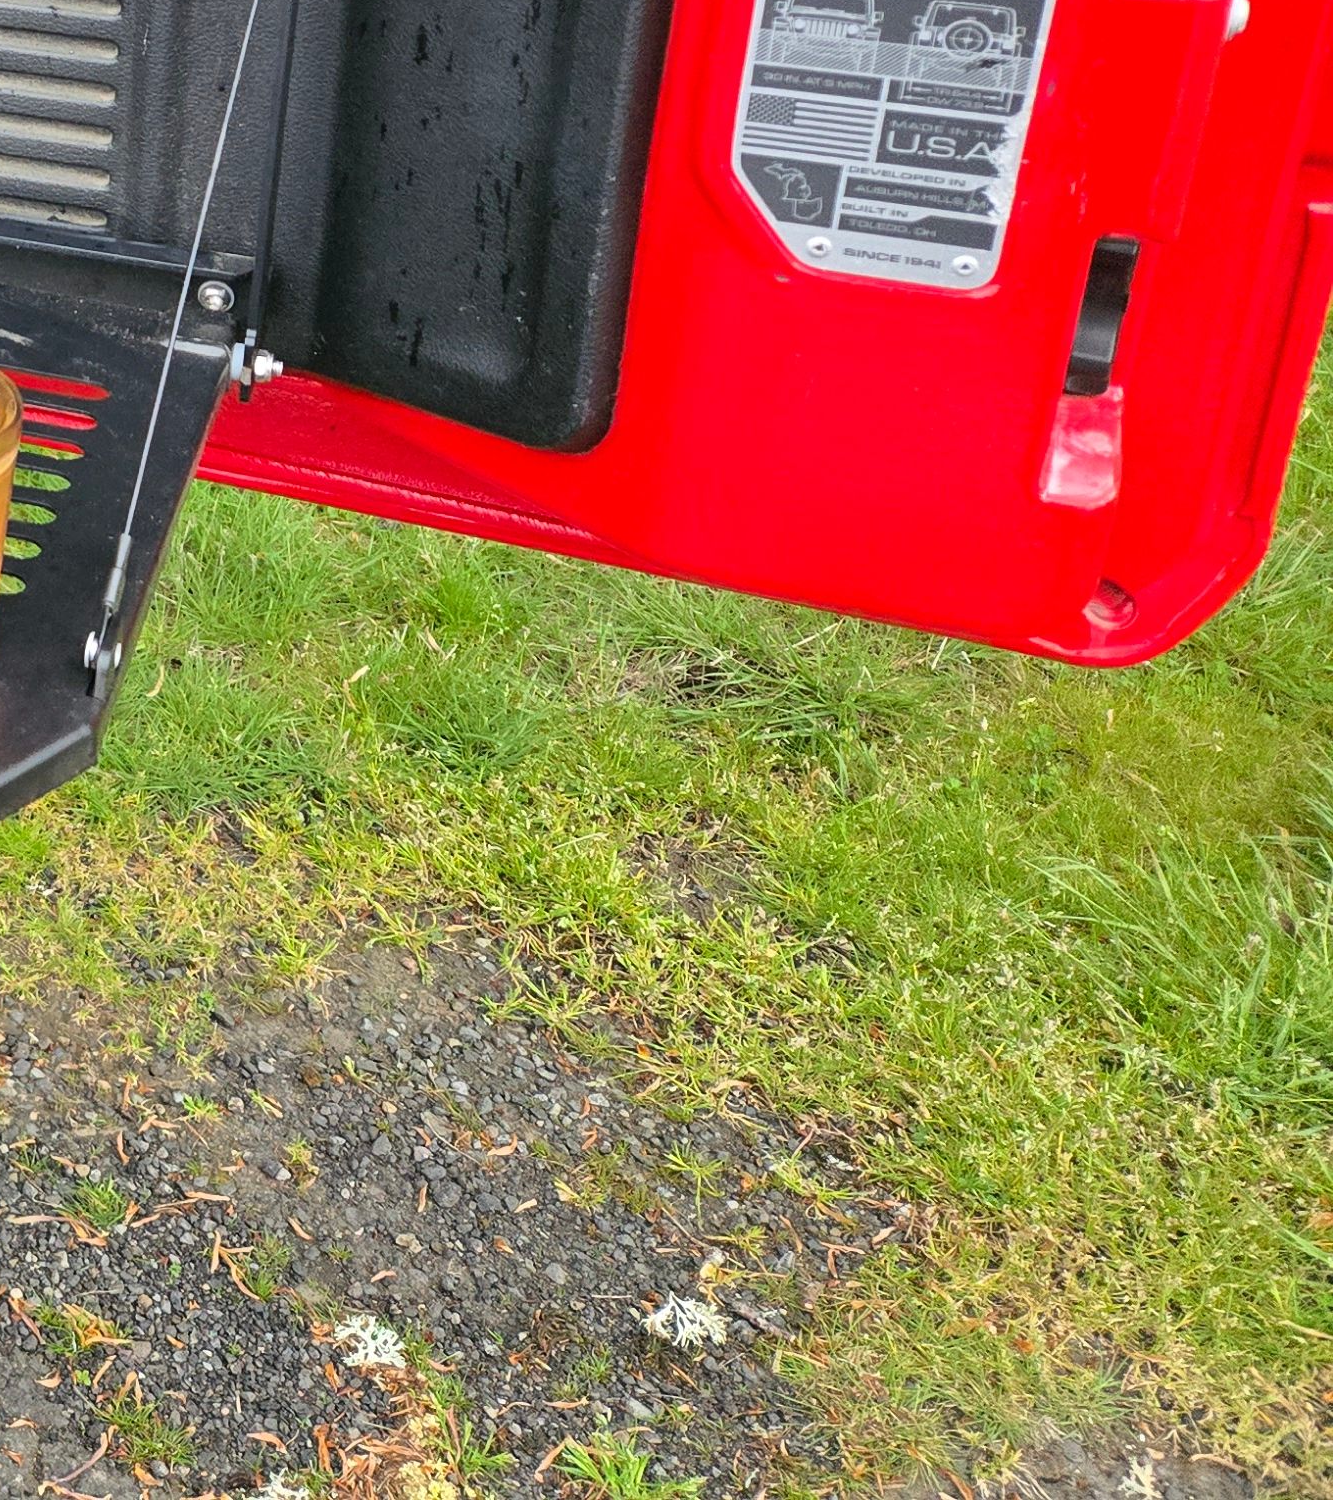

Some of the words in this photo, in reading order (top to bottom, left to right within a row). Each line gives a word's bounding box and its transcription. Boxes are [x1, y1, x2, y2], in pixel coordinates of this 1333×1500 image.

[890, 119, 945, 134] MADE
[951, 127, 968, 136] IN
[975, 130, 1006, 140] TH
[848, 165, 945, 184] DEVELOPED
[949, 178, 966, 187] IN
[854, 184, 919, 199] AUBURN
[841, 202, 888, 215] BUILT
[889, 207, 909, 218] IN
[914, 227, 937, 237] OH
[843, 247, 902, 263] SINCE
[904, 256, 941, 269] 1941
